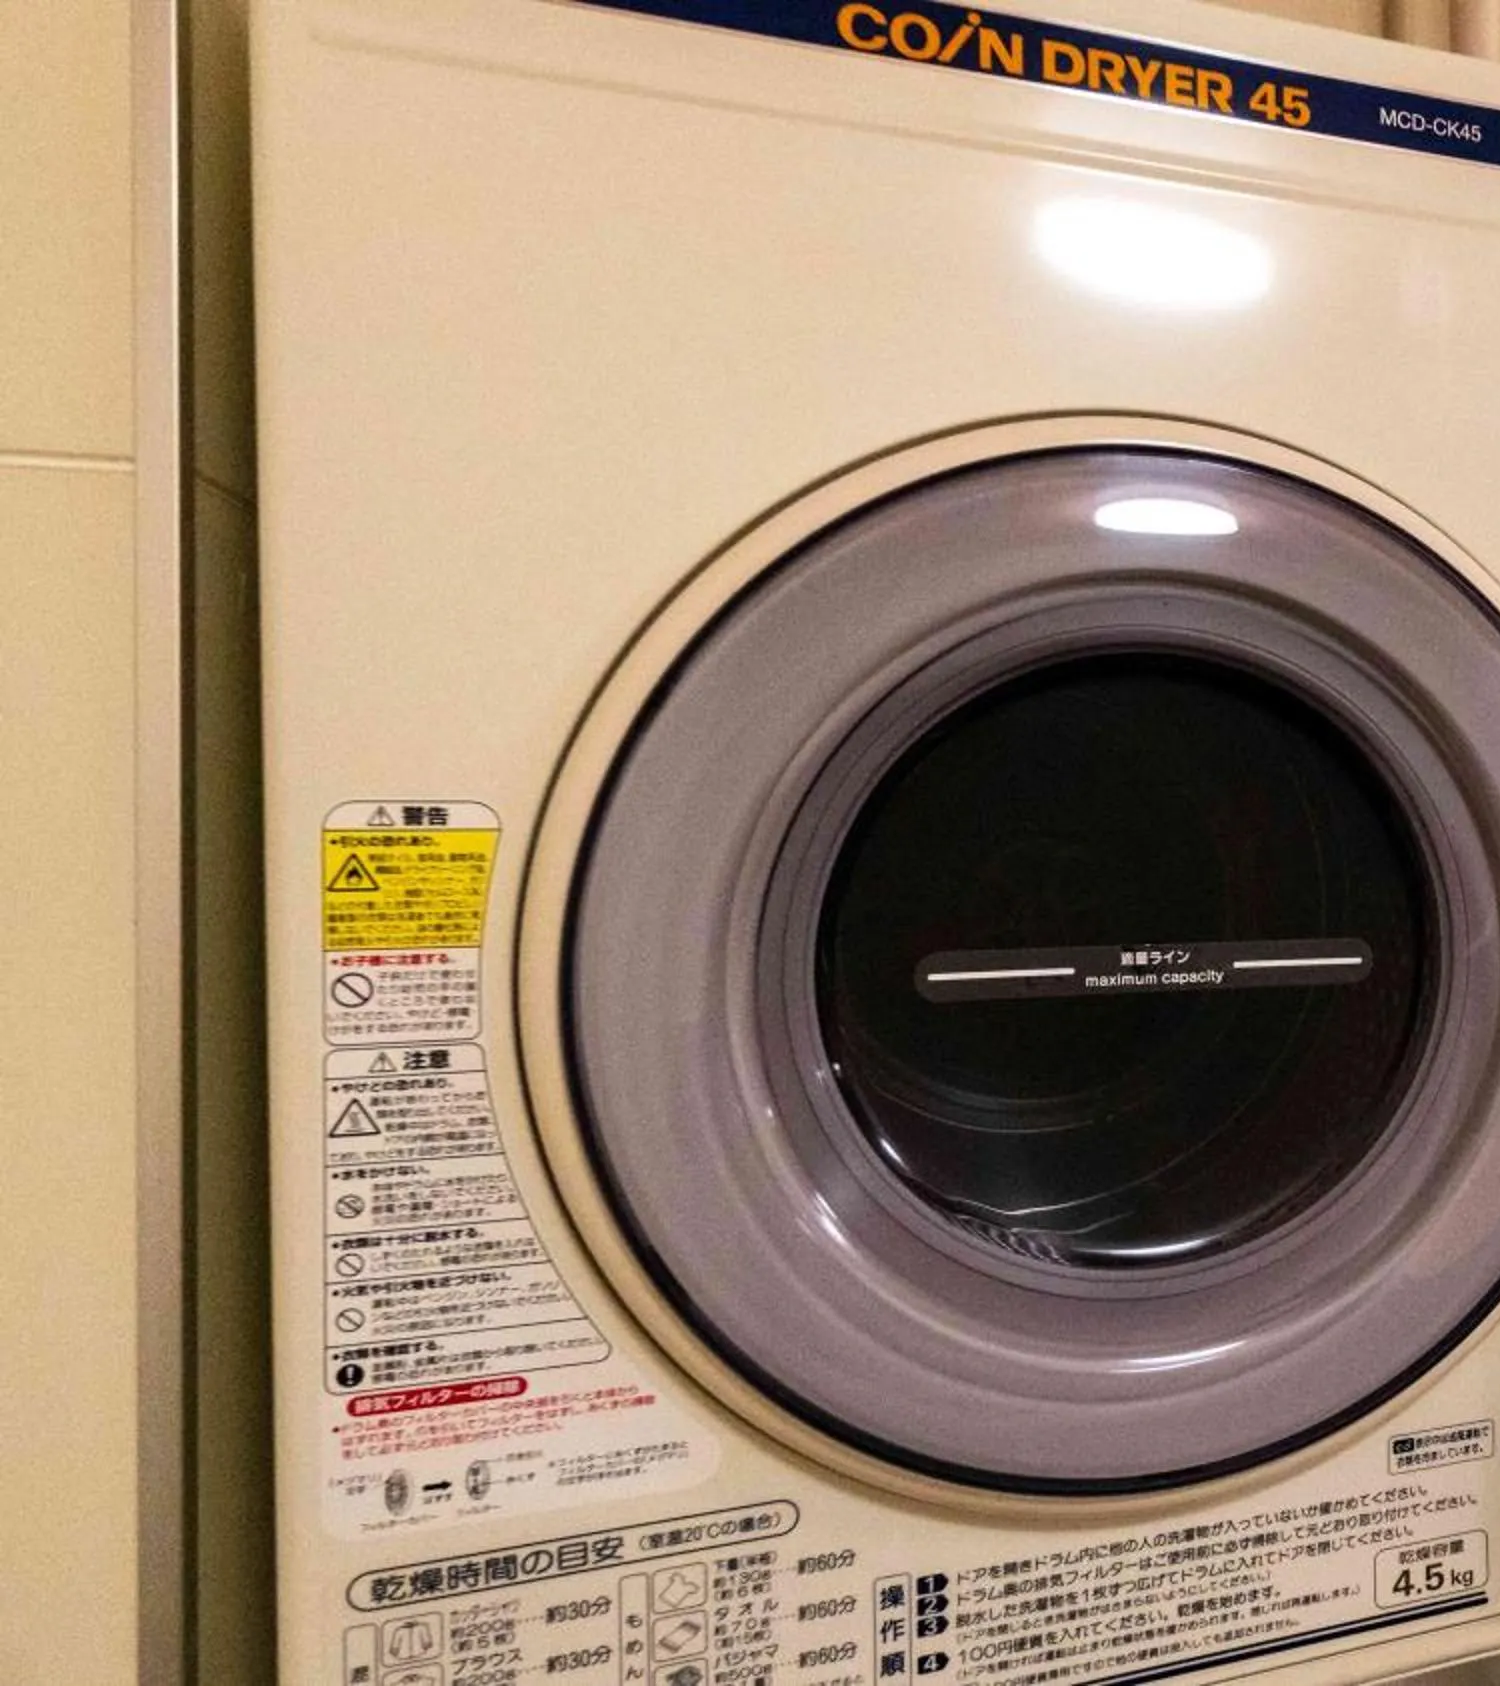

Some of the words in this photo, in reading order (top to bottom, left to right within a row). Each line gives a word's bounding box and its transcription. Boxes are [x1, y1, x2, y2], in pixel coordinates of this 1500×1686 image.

[1042, 39, 1233, 114] DRYER
[1249, 82, 1311, 128] 45
[1379, 107, 1482, 142] MCD-CK45
[402, 806, 448, 826] 警告
[1085, 972, 1157, 987] maximum
[1161, 969, 1224, 985] capacity
[402, 1050, 450, 1070] 注意
[798, 1549, 855, 1575] 約60分
[1399, 1539, 1464, 1565] 乾燥容量
[371, 1536, 624, 1603] 乾燥時間の目安
[1392, 1562, 1444, 1597] 4.5
[1451, 1569, 1473, 1586] kg
[546, 1596, 611, 1624] 約30分
[798, 1595, 856, 1621] 約60分
[547, 1646, 611, 1673] 約30分
[625, 1614, 643, 1681] もめん
[715, 1644, 779, 1668] パジャマ
[799, 1642, 857, 1668] 約60分
[451, 1649, 523, 1675] ブラウス
